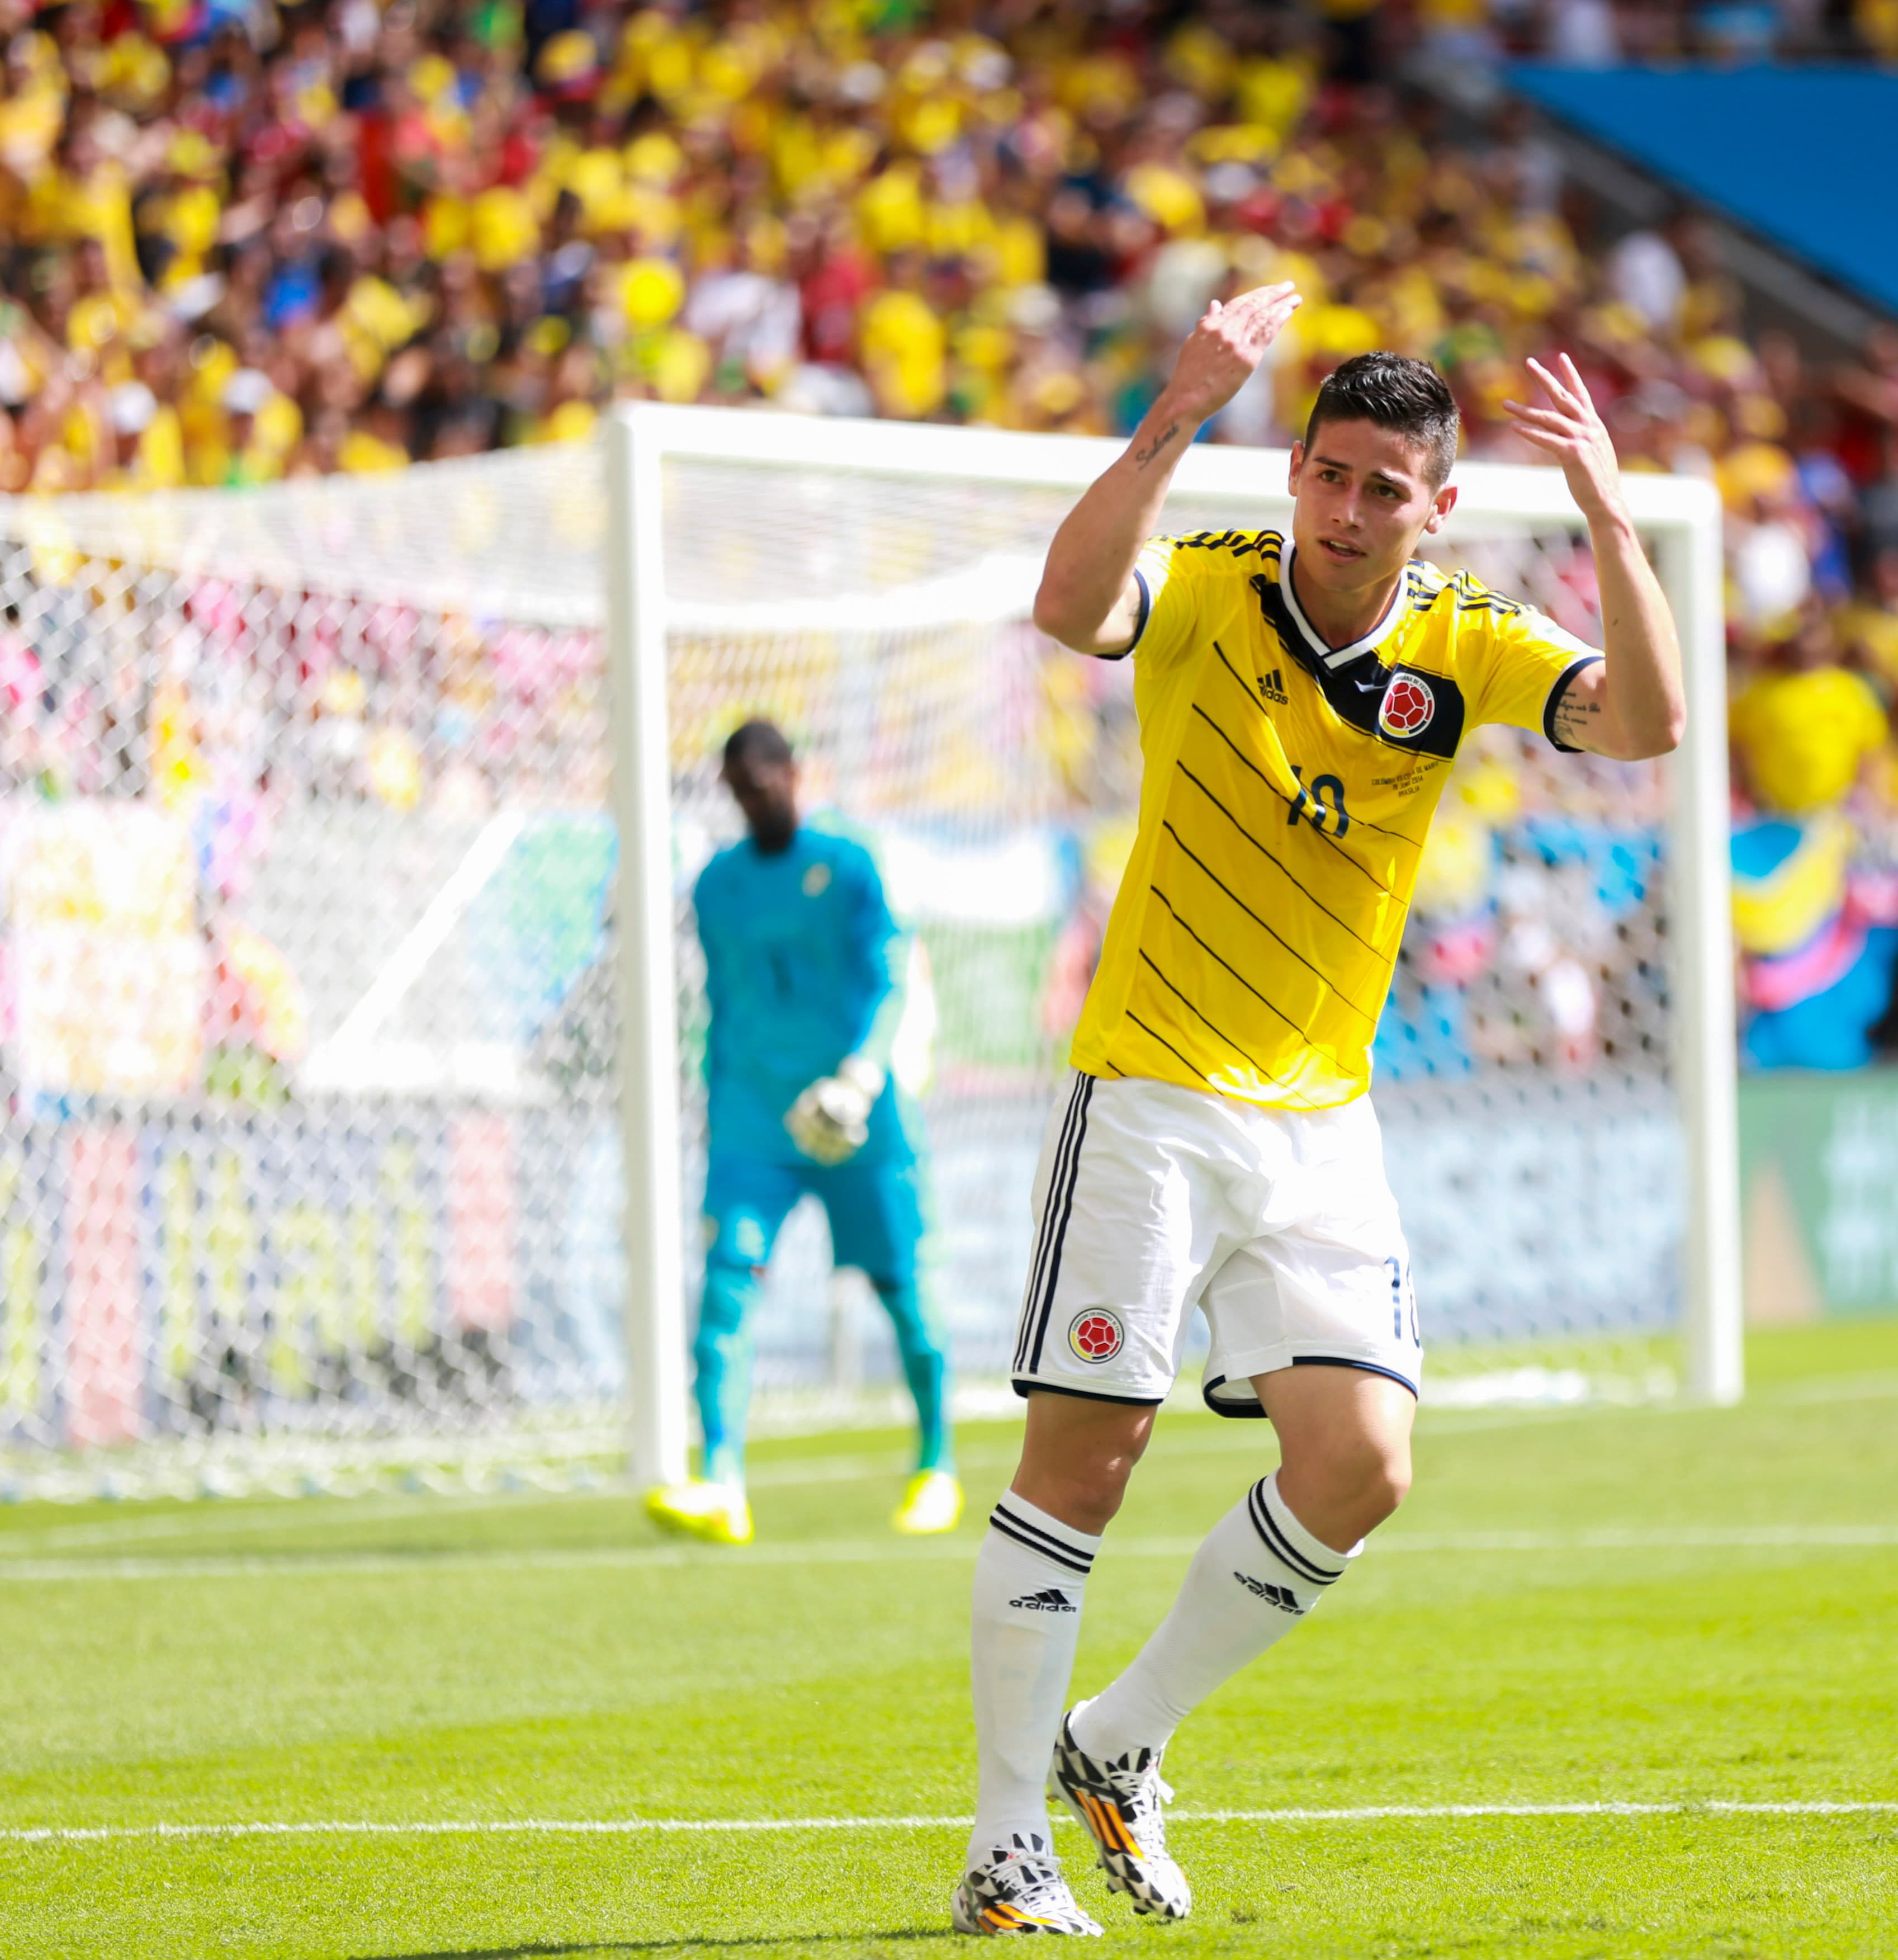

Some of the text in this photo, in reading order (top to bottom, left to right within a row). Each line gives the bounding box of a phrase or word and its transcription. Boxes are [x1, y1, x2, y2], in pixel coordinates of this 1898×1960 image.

[1288, 765, 1348, 839] 10
[1009, 1600, 1077, 1613] adidas
[1233, 1571, 1305, 1615] adidas
